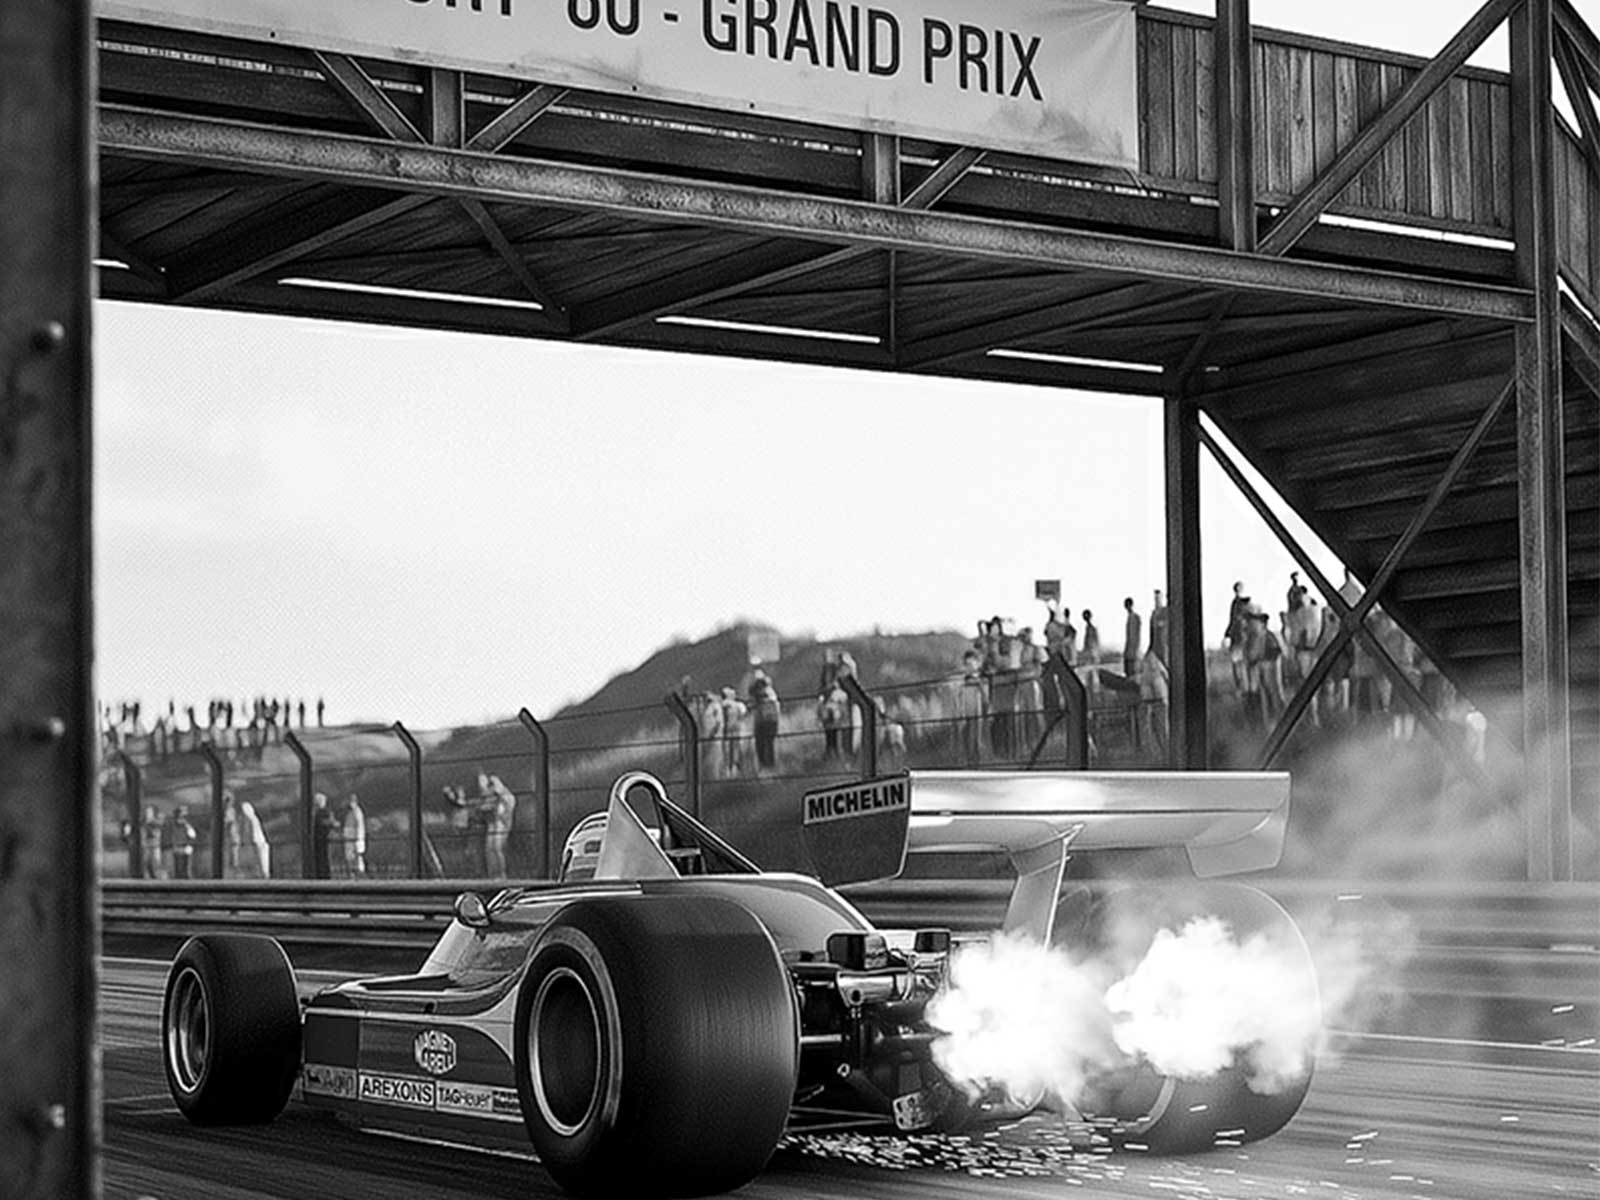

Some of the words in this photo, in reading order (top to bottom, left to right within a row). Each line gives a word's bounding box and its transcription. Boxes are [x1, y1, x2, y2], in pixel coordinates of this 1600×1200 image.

[702, 0, 900, 77] GRAND
[923, 18, 1043, 101] PRIX
[808, 783, 904, 819] MICHELIN
[363, 1078, 432, 1102] AREXONS
